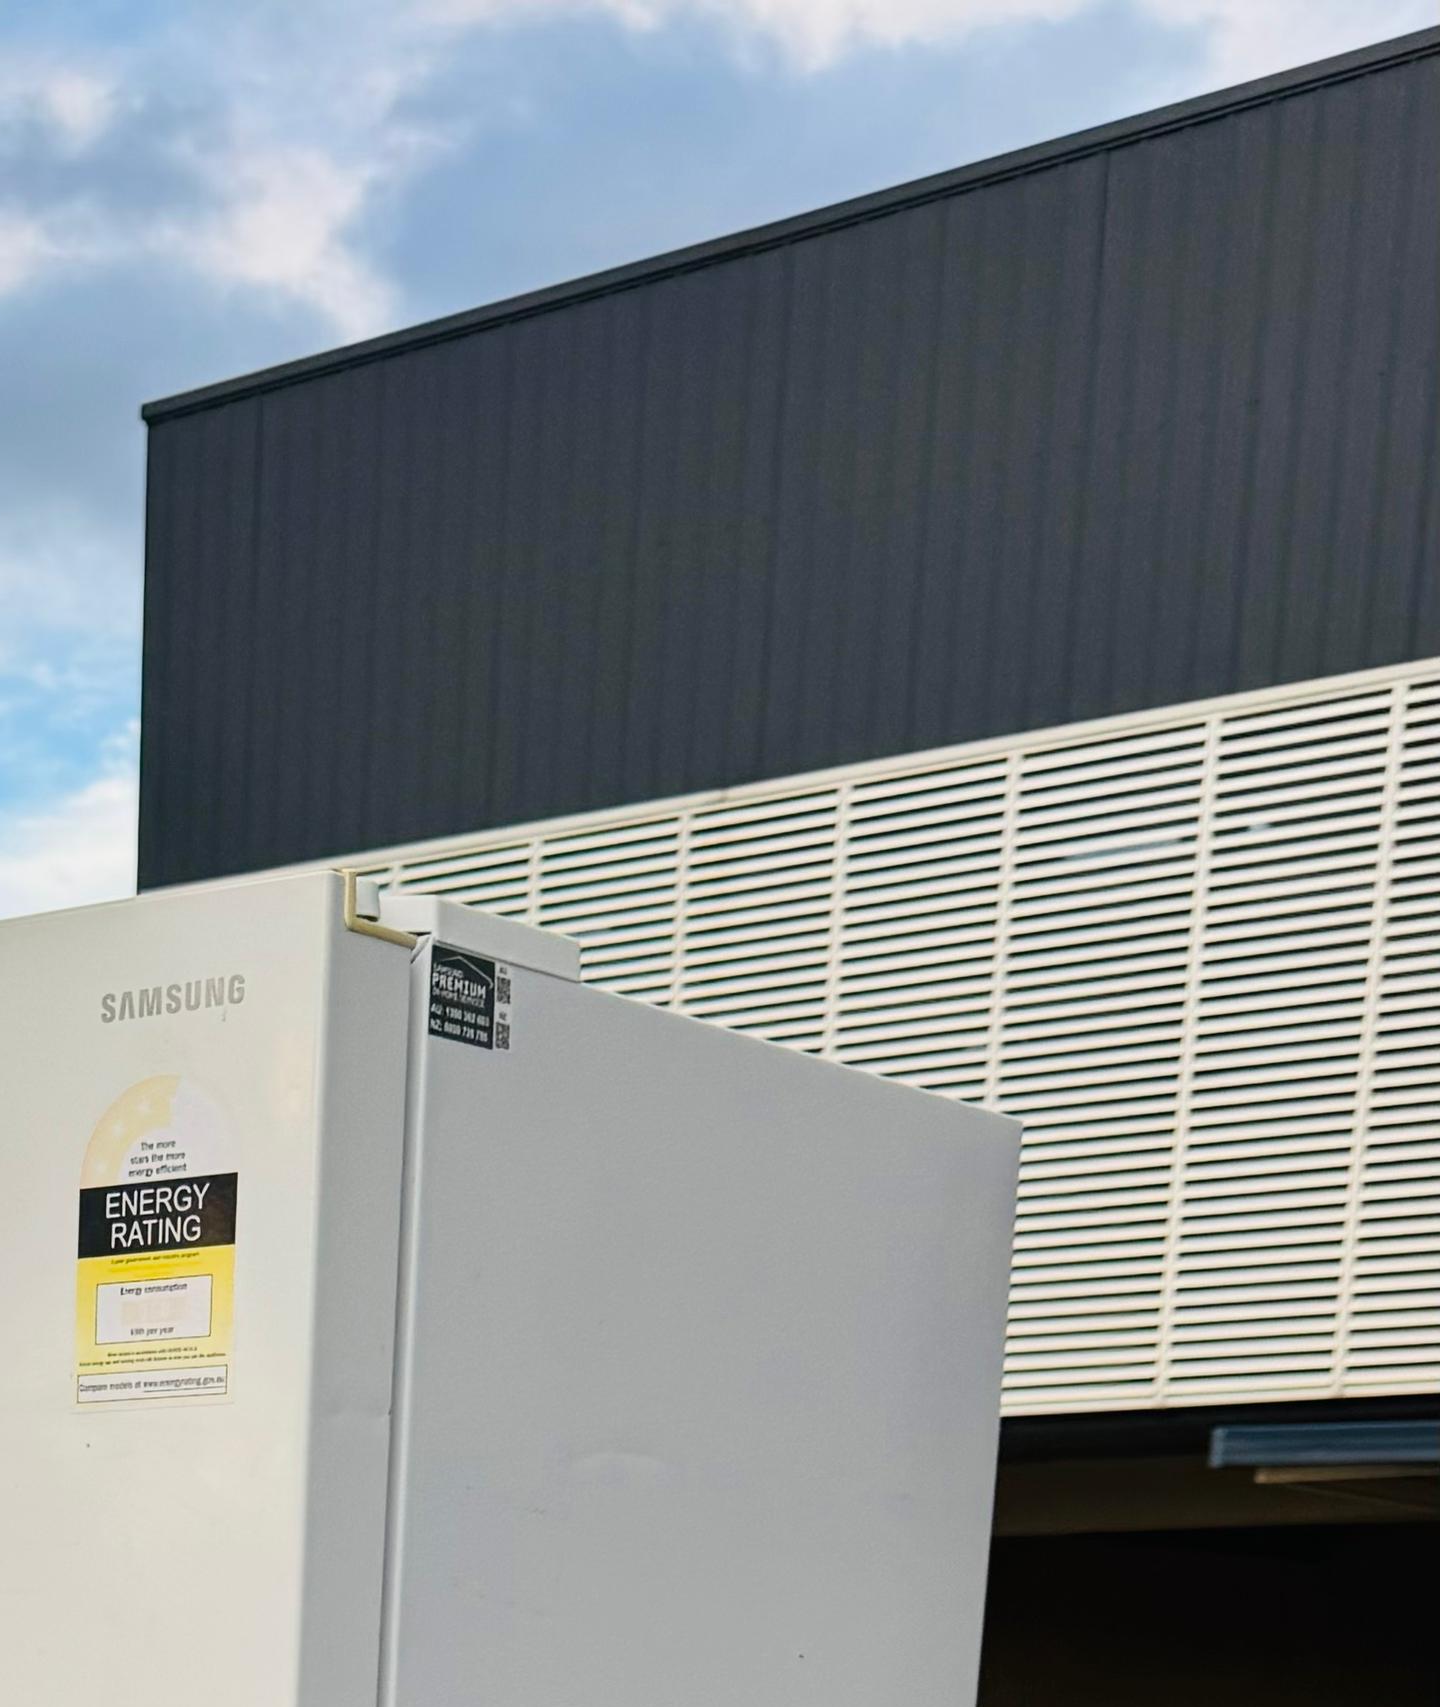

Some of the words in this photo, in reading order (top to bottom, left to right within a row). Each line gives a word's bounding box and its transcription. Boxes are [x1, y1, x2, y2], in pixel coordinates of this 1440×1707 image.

[101, 974, 247, 1024] SAMSUNG
[432, 972, 486, 1000] PREMIUM
[130, 1156, 149, 1165] stars
[151, 1153, 164, 1163] the
[165, 1152, 186, 1161] more
[141, 1142, 154, 1151] The
[156, 1140, 176, 1149] more
[128, 1167, 153, 1178] energy
[155, 1163, 187, 1174] efficient
[106, 1182, 210, 1219] ENERGY
[111, 1214, 202, 1249] RATING
